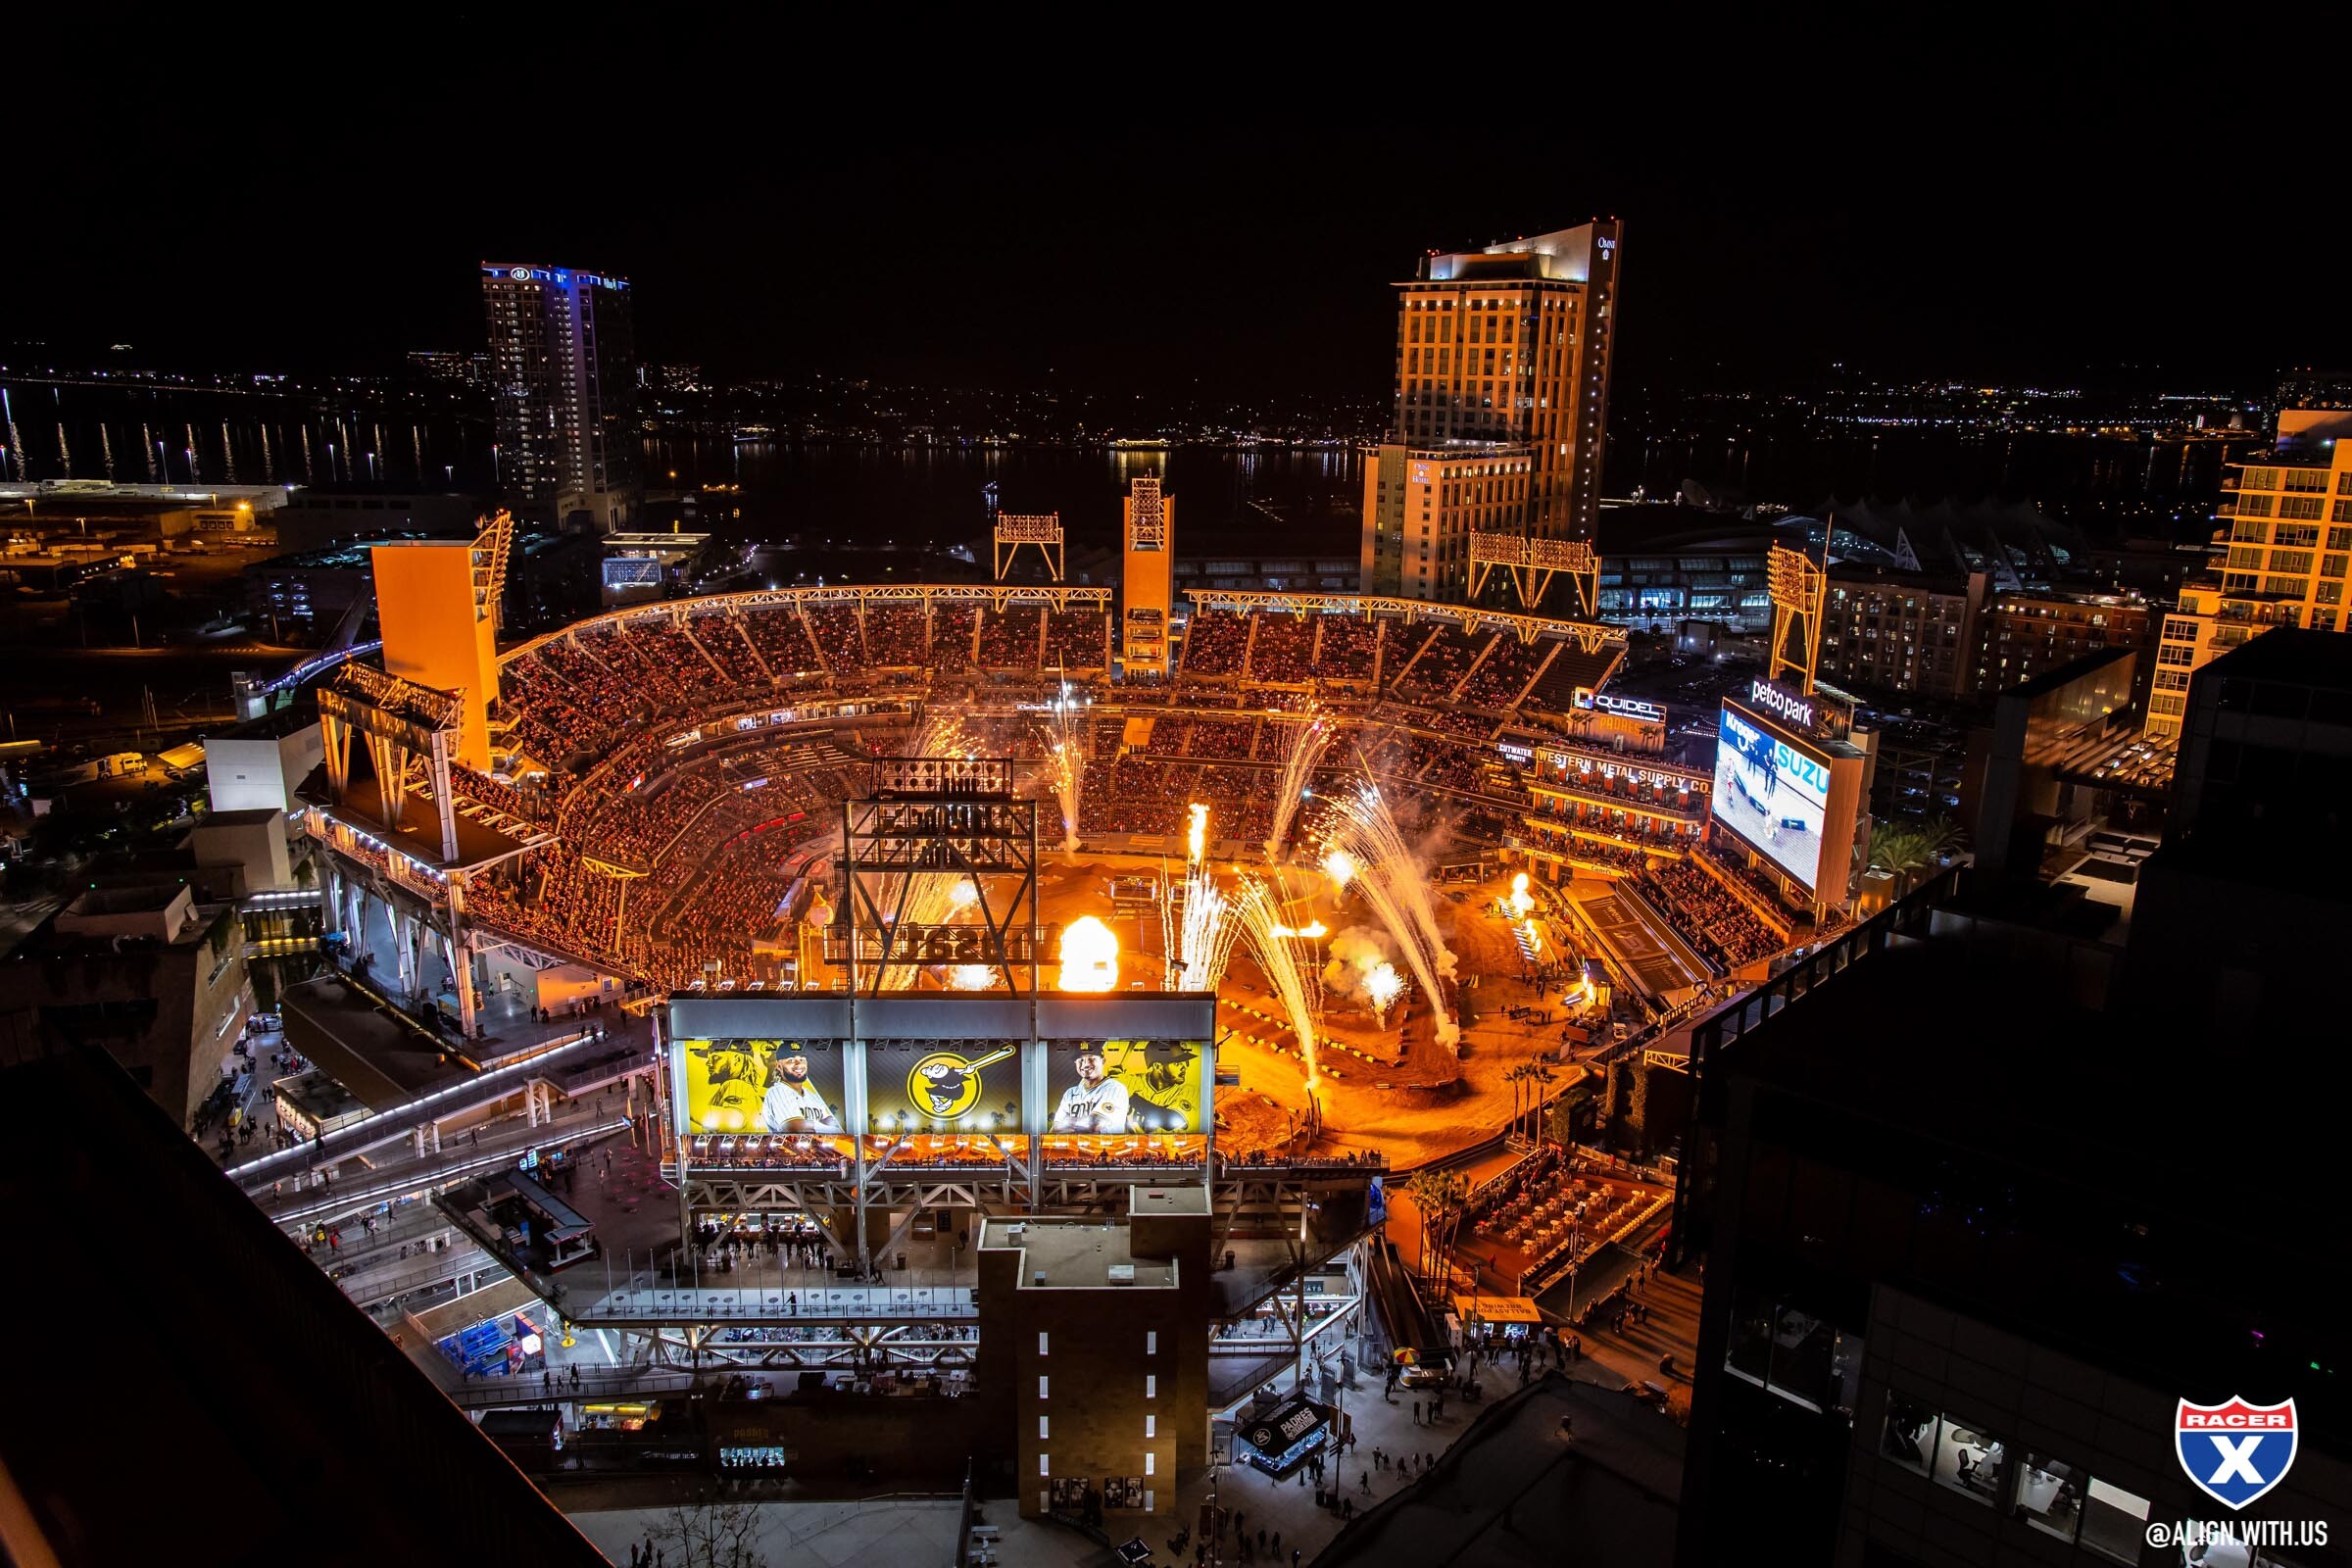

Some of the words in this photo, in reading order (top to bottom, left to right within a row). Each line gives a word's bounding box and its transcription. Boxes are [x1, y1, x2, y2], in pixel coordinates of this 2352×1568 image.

[1596, 695, 1660, 715] QUIDEL
[1752, 680, 1784, 710] petco
[1784, 697, 1813, 727] park
[1599, 715, 1641, 737] PADRES
[1726, 711, 1760, 752] Kroger
[1498, 744, 1533, 758] CUTWATER
[1539, 750, 1592, 770] WESTERN
[1596, 761, 1635, 778] METAL
[1639, 769, 1686, 788] SUPPLY
[1690, 780, 1712, 794] CO.
[1280, 1407, 1314, 1433] PADRES
